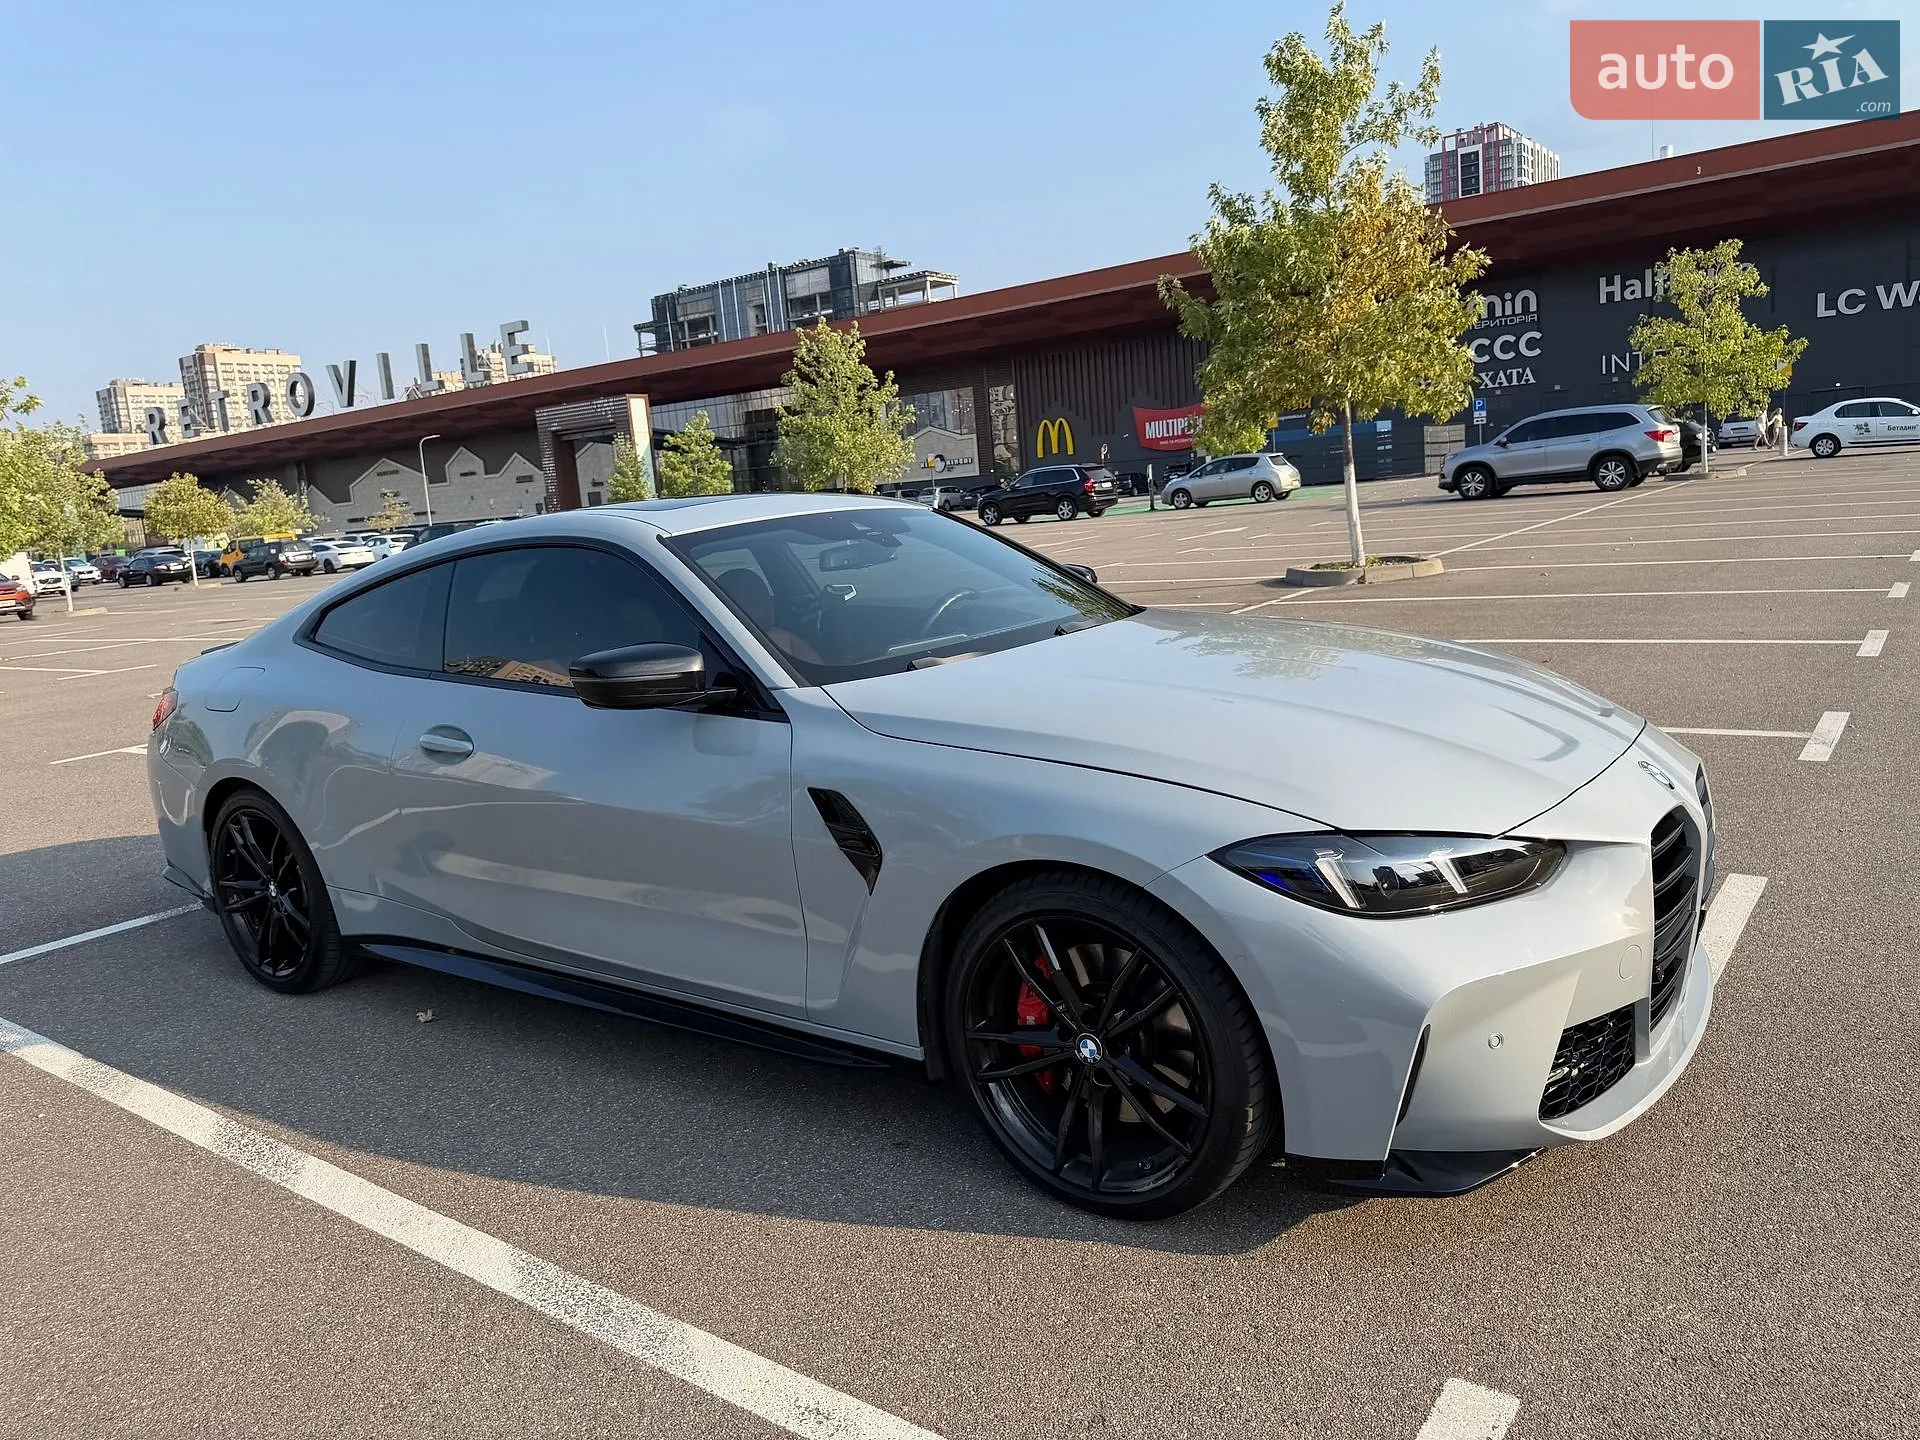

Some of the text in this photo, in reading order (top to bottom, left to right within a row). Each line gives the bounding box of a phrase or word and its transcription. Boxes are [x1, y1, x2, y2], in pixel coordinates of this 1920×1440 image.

[1817, 280, 1920, 318] LC W
[1468, 331, 1542, 363] CCC
[145, 320, 534, 445] RETROVILLE
[1475, 400, 1484, 411] P
